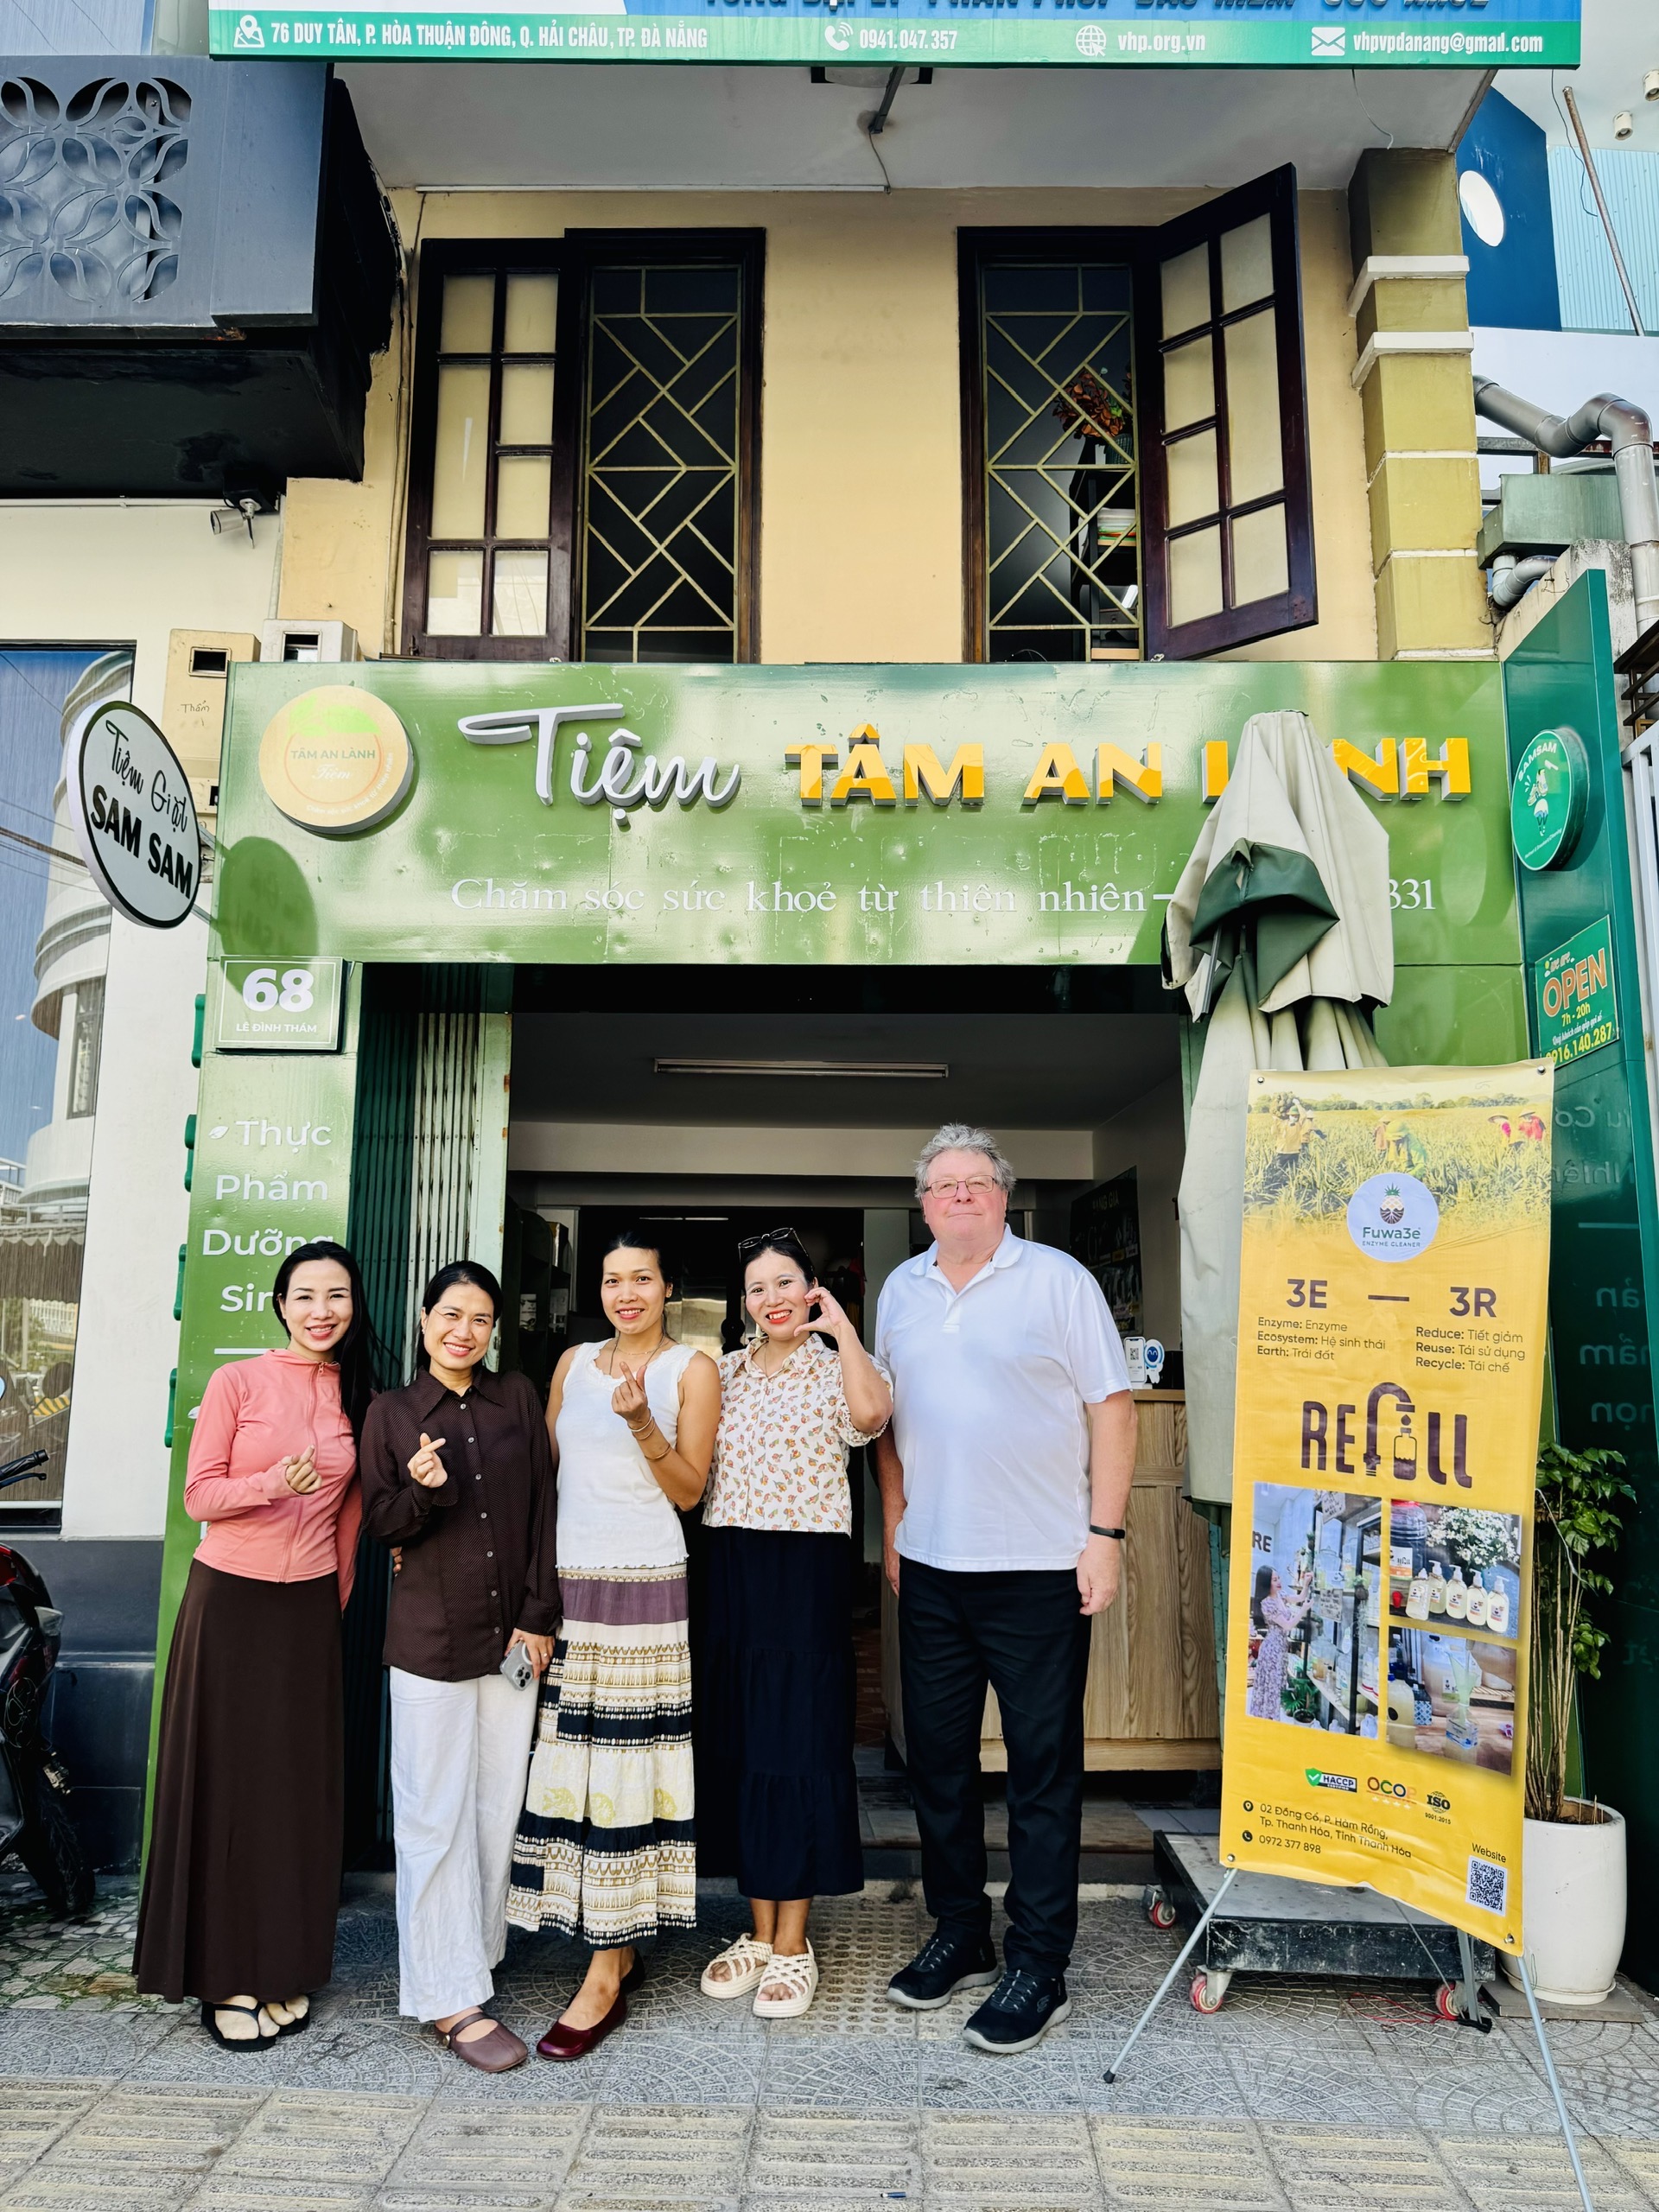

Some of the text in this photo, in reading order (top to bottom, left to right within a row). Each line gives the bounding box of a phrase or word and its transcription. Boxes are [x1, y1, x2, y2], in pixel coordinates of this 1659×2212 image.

[271, 18, 708, 49] 76 DUY TÂN, P. HÒA THUẬN ĐÔNG, Q. HẢI CHÂU, TP. ĐÀ NẴNG
[860, 29, 957, 50] 0941.047.357
[1117, 31, 1206, 53] vhp.org.vn
[1353, 31, 1543, 54] vhpvpdanang@gmail.com
[106, 720, 143, 794] Tiệm
[291, 747, 375, 760] TÂM AN LÀNH
[458, 702, 741, 827] Tiệm
[785, 723, 983, 807] TÂM
[1021, 741, 1163, 805] AN
[1518, 741, 1557, 781] SAMSAM
[91, 785, 193, 899] SAM SAM
[451, 879, 567, 912] Chăm
[585, 878, 645, 912] sóc
[664, 878, 725, 912] sức
[747, 880, 836, 912] khoẻ
[858, 878, 899, 912] từ
[921, 880, 1017, 913] thiên
[243, 968, 314, 1013] 68
[1543, 947, 1607, 1017] OPEN
[1561, 1013, 1571, 1027] 7h
[1576, 1002, 1591, 1020] 20h
[236, 1021, 317, 1033] LÊ ĐÌNH THÁM
[236, 1120, 332, 1154] Thực
[216, 1170, 327, 1201] Phẩm
[202, 1228, 334, 1255] Dưỡn
[1363, 1227, 1421, 1239] Fuwa3e
[1287, 1278, 1327, 1309] 3E
[1449, 1287, 1497, 1318] 3R
[1258, 1317, 1347, 1332] Enzyme: Enzyme
[1416, 1326, 1464, 1339] Reduce:
[1467, 1329, 1489, 1341] Tiết
[1257, 1331, 1386, 1350] Ecosystem: Hệ sinh thái
[1416, 1342, 1525, 1361] Reuse: Tái sử dụng
[1257, 1345, 1334, 1360] Earth: Trái đất
[1416, 1357, 1510, 1373] Recycle: Tái chế
[1324, 1775, 1354, 1786] HACCP
[1367, 1777, 1417, 1799] OCOP
[1427, 1794, 1451, 1810] ISO
[1260, 1803, 1272, 1814] 02
[1325, 1815, 1332, 1825] P.
[1425, 1813, 1452, 1825] 9001:2015
[1259, 1834, 1321, 1853] 0972 377 898
[1260, 1815, 1274, 1827] Tp.
[1276, 1819, 1307, 1833] Thanh
[1359, 1835, 1389, 1852] Thanh
[1391, 1845, 1411, 1858] Hóa
[1472, 1842, 1506, 1863] Website
